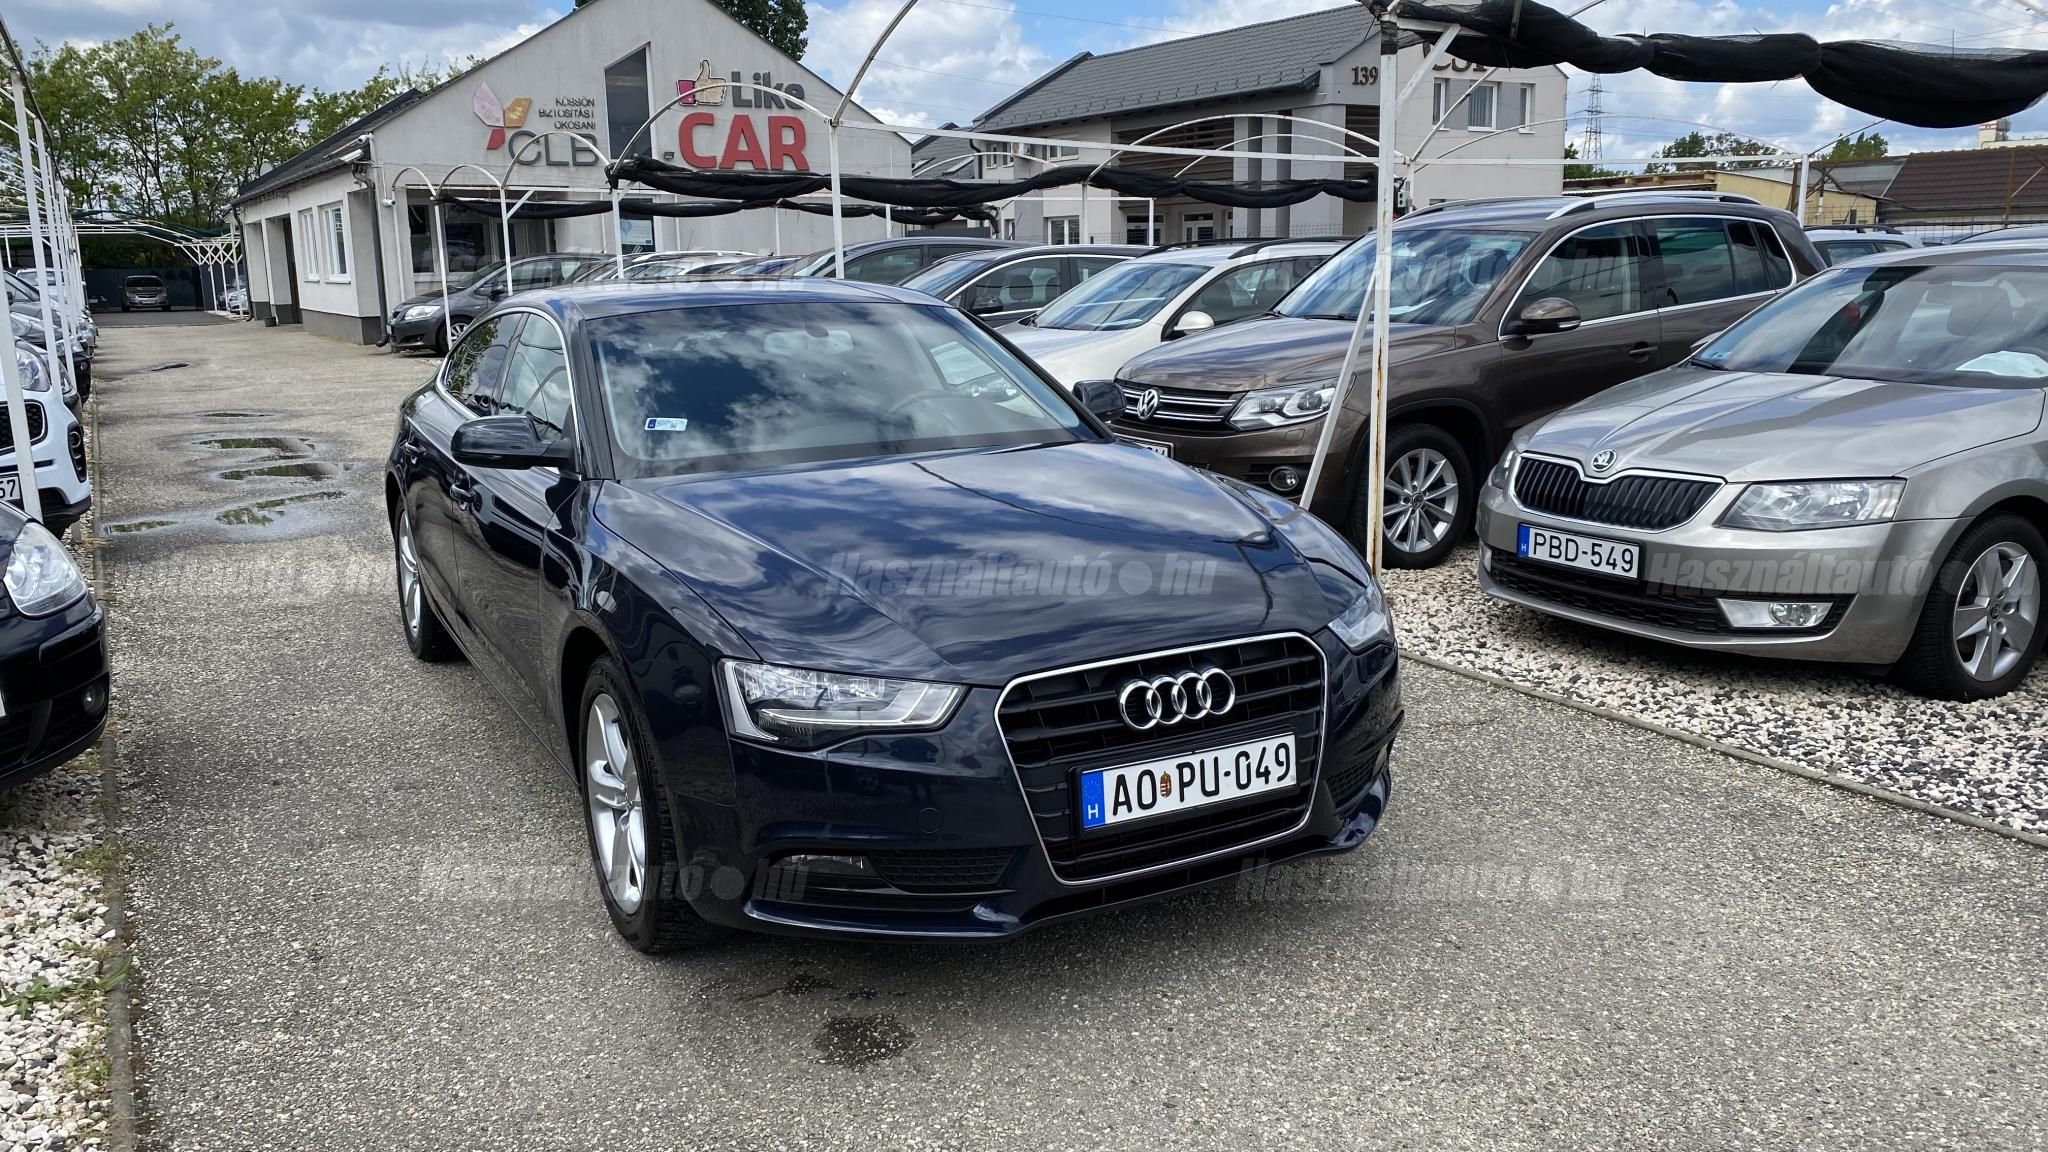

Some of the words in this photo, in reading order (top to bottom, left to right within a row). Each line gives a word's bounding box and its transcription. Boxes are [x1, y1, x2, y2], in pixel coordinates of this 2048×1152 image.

[731, 71, 805, 110] Like
[1351, 66, 1379, 86] 139
[508, 130, 600, 167] CLB
[678, 112, 810, 171] CAR
[1533, 532, 1634, 573] PBD-549
